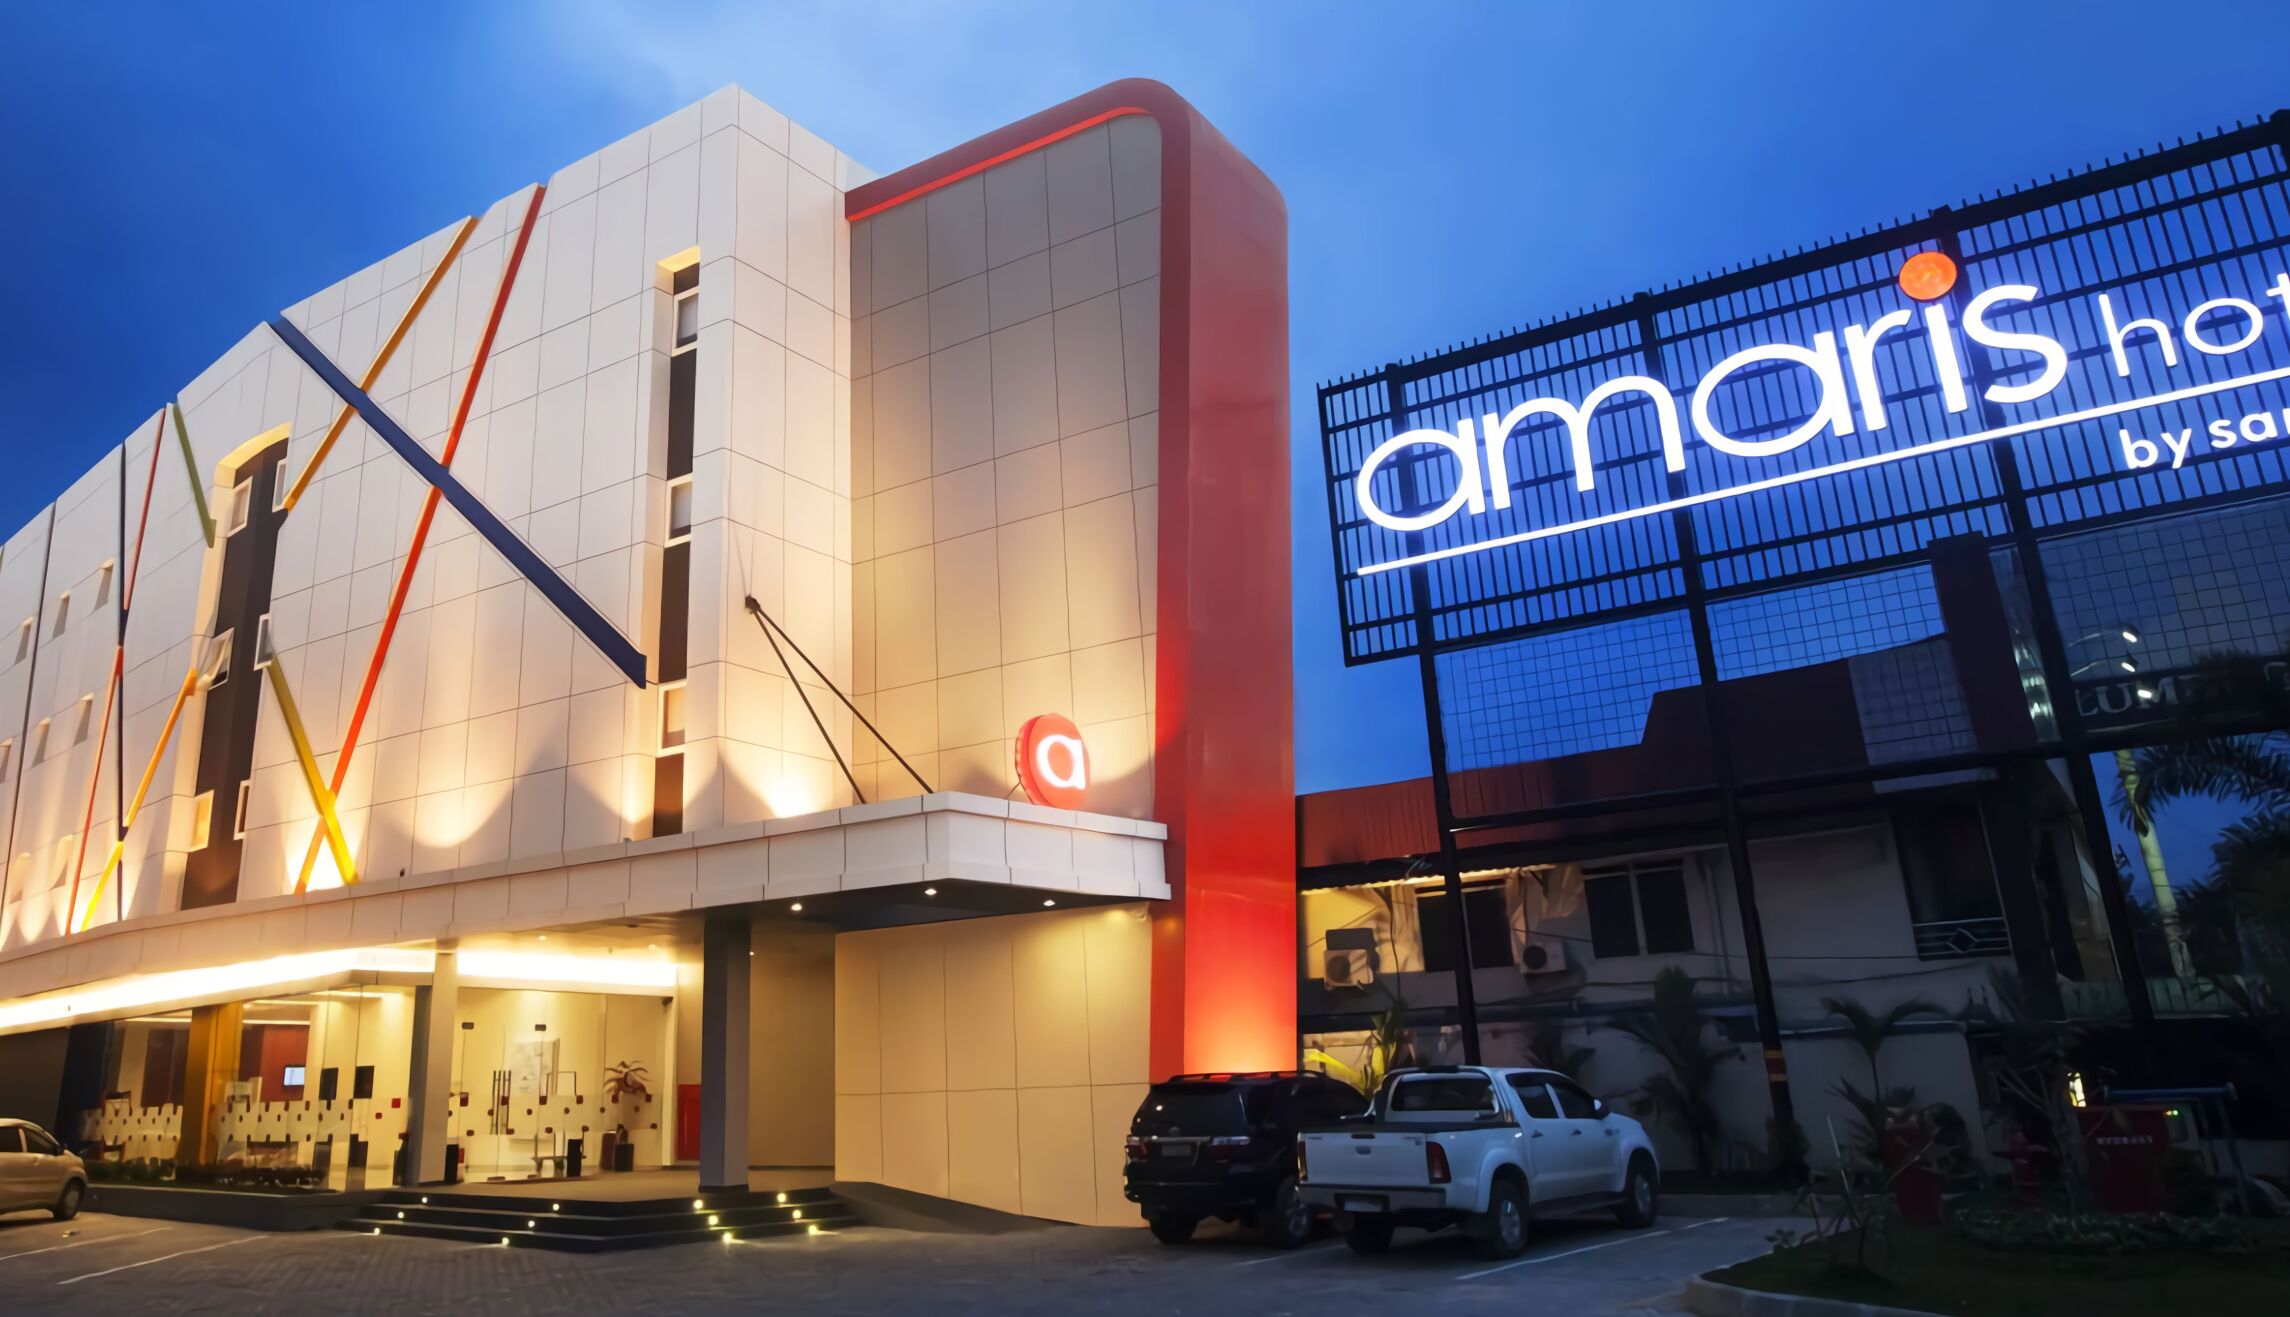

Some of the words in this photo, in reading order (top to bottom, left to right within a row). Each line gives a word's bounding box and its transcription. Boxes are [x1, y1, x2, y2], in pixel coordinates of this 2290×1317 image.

[1356, 251, 2068, 532] amaris
[2118, 429, 2192, 469] by
[2208, 407, 2290, 449] sa
[1036, 733, 1087, 790] a
